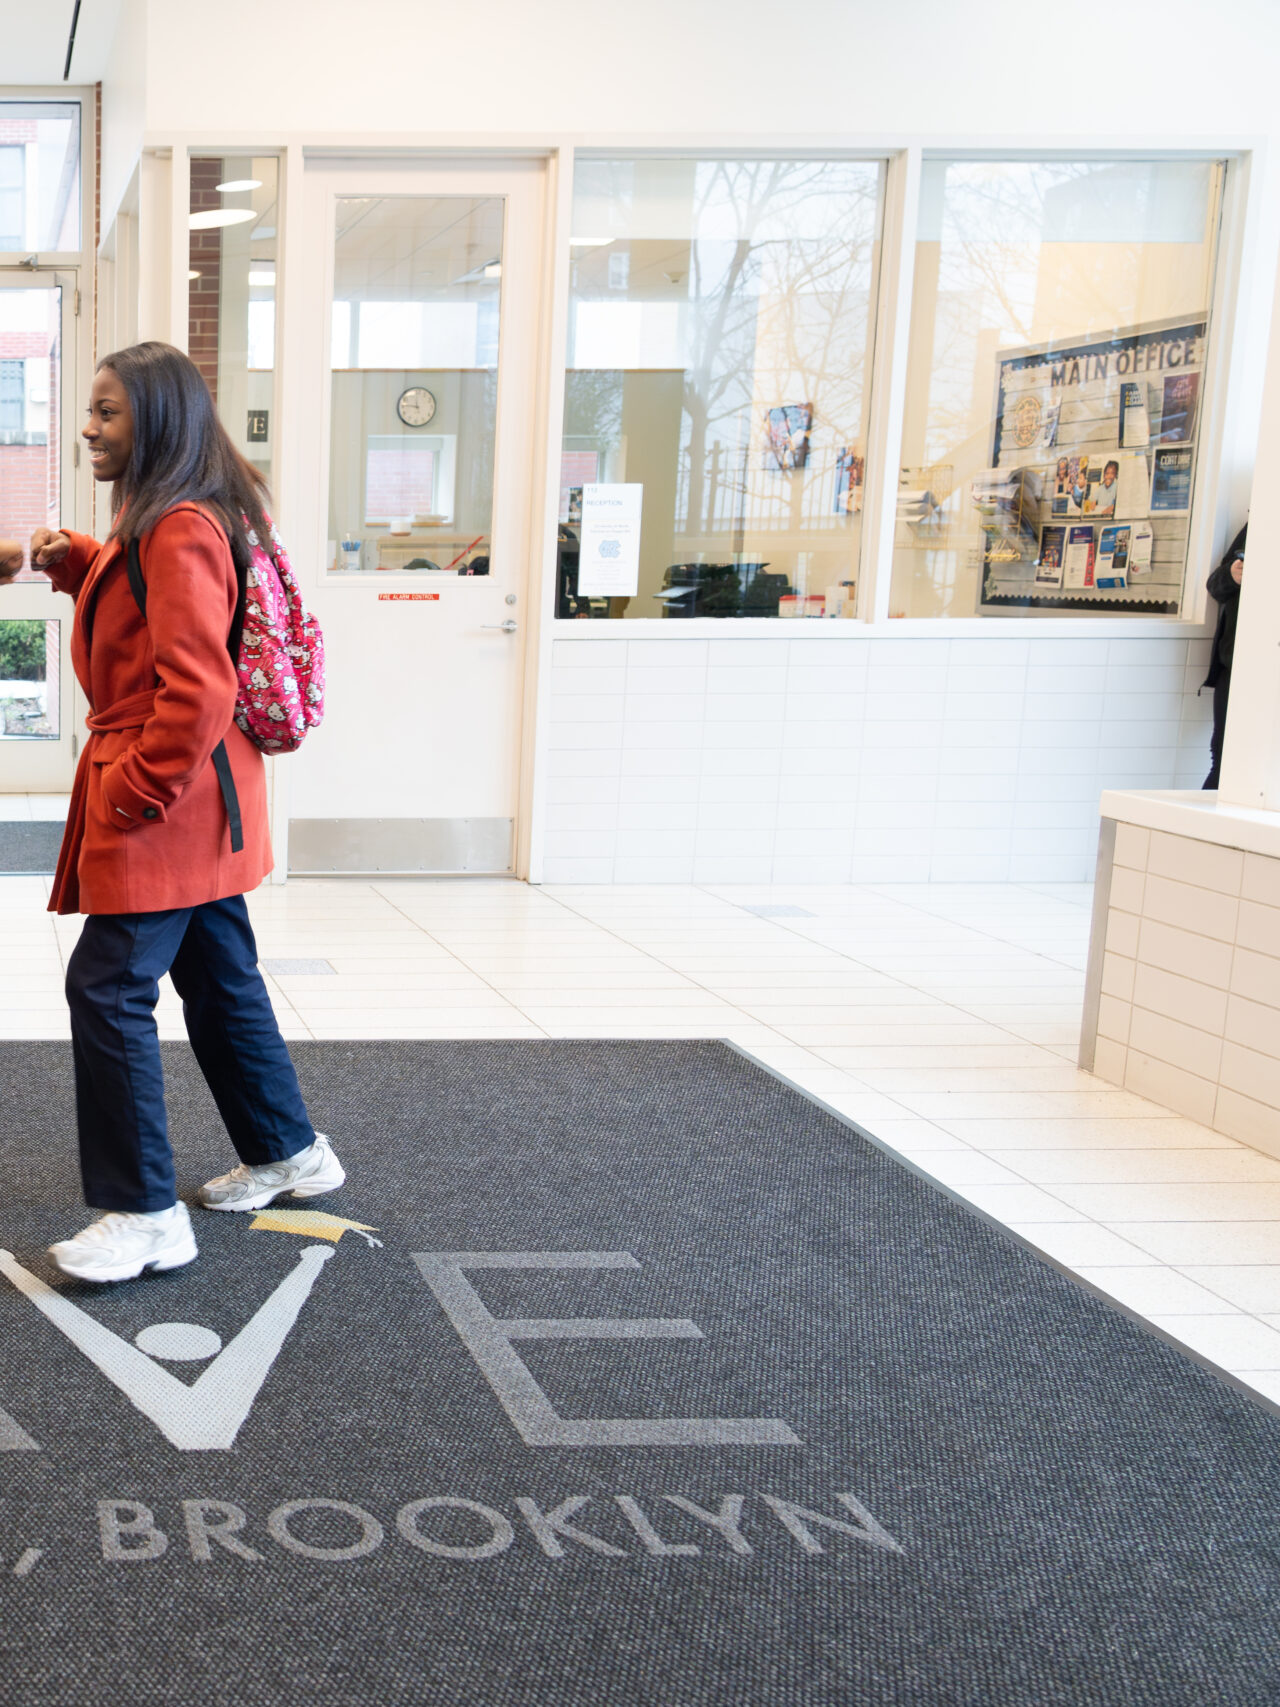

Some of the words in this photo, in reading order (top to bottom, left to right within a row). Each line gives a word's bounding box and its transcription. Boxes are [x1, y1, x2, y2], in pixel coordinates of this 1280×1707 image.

[1051, 354, 1109, 387] MAIN
[1116, 340, 1196, 374] OFFICE
[586, 499, 624, 507] RECEPTION
[96, 1492, 906, 1562] BROOKLYN
